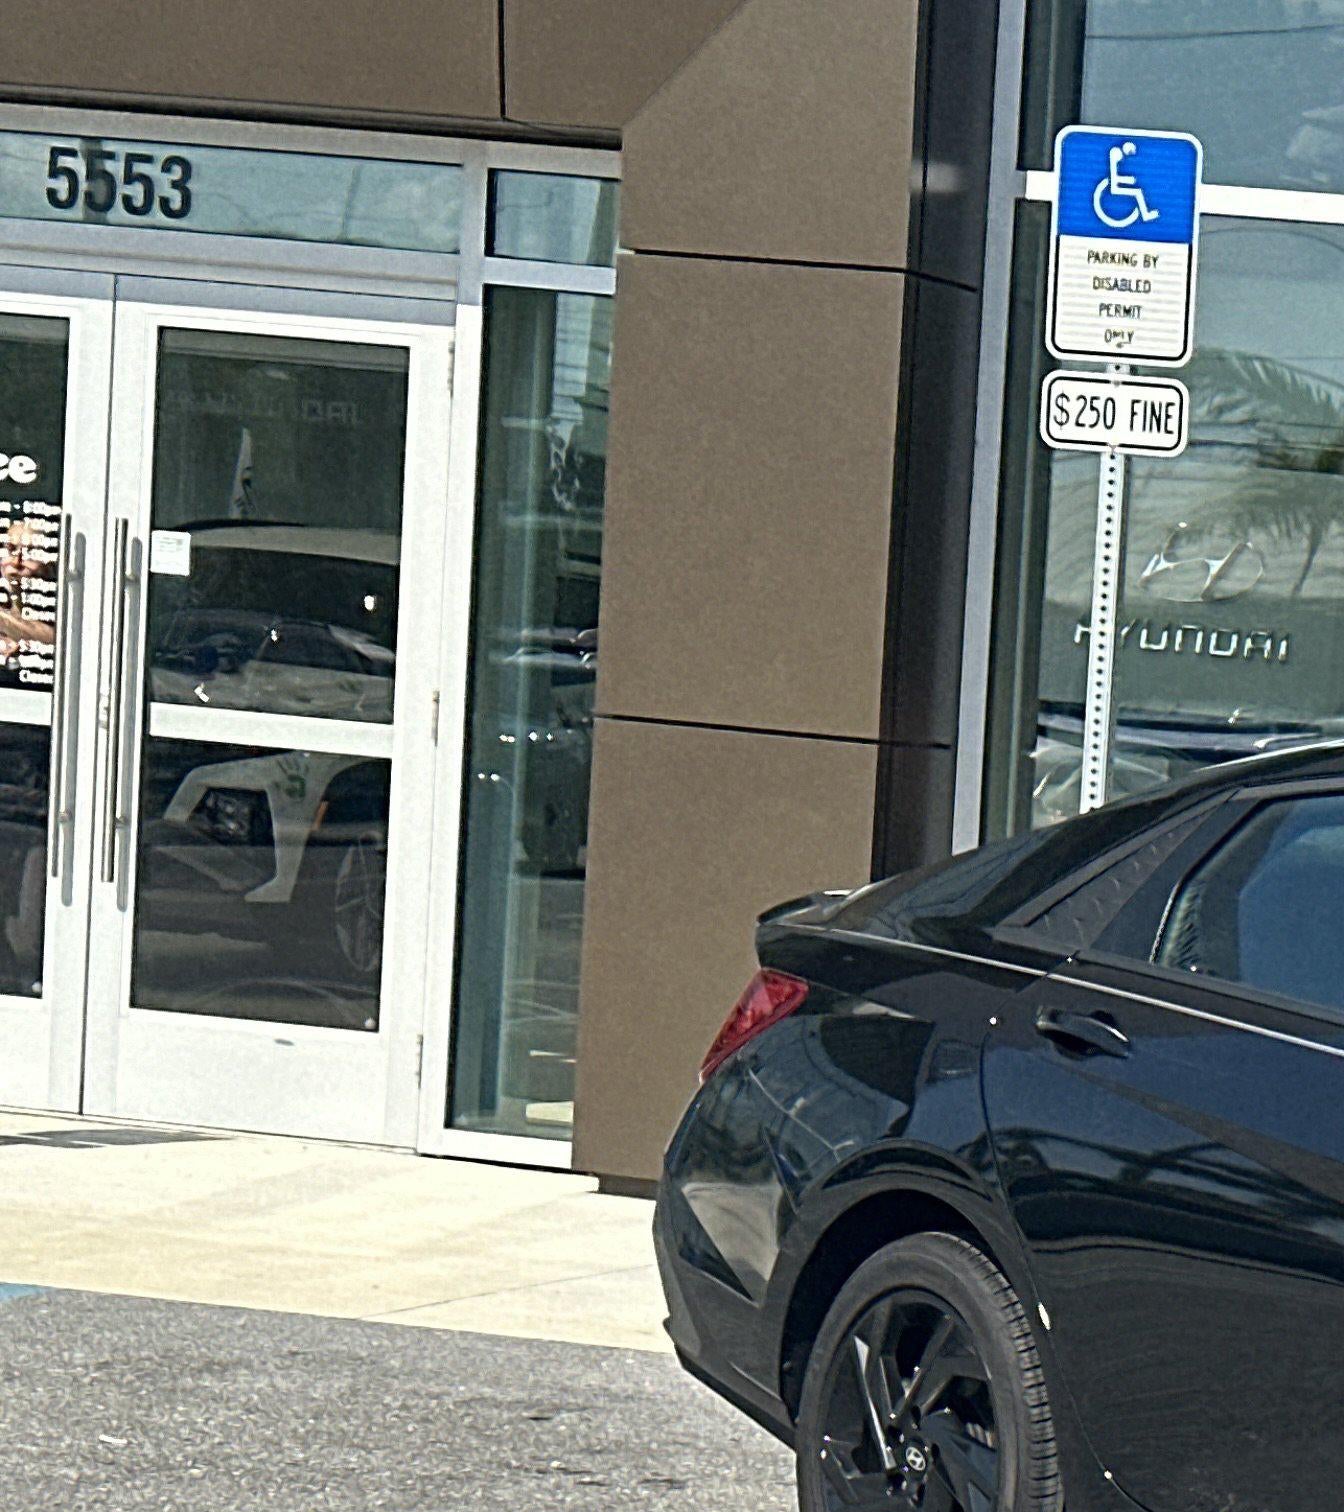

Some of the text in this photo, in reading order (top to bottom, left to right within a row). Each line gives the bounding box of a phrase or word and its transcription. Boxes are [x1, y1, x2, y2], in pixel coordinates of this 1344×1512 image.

[45, 146, 192, 219] 5553
[1087, 249, 1160, 269] PARKING BY
[1092, 276, 1152, 294] DISABLED
[1099, 303, 1142, 319] PERMIT
[1053, 389, 1176, 435] $250 FINE
